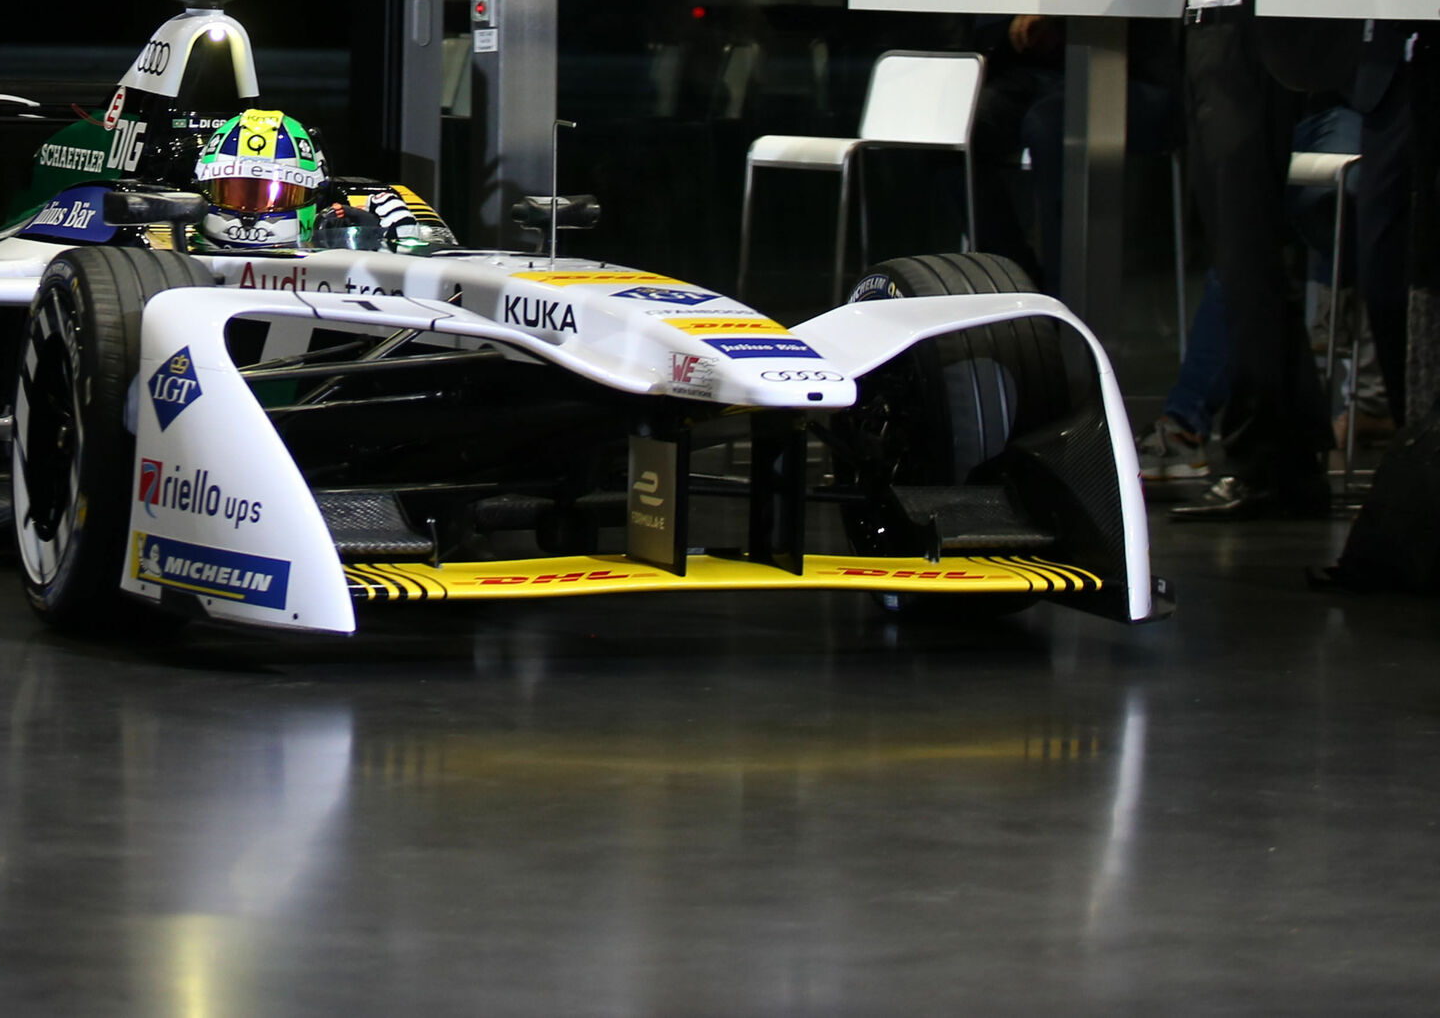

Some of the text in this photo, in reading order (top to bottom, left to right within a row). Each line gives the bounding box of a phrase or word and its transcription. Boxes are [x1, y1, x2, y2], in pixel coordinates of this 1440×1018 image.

[40, 143, 106, 173] SCHAEFFLER
[106, 119, 147, 172] DIG
[201, 160, 315, 188] Audi e-tron
[63, 201, 97, 230] Bär
[239, 261, 307, 292] Audi
[504, 294, 578, 334] KUKA
[720, 343, 773, 353] Julius
[672, 353, 700, 383] WE
[153, 374, 197, 405] LGT
[162, 465, 263, 529] riello ups
[164, 555, 274, 592] MICHELIN
[474, 570, 629, 585] DHL
[836, 567, 986, 580] DHL
